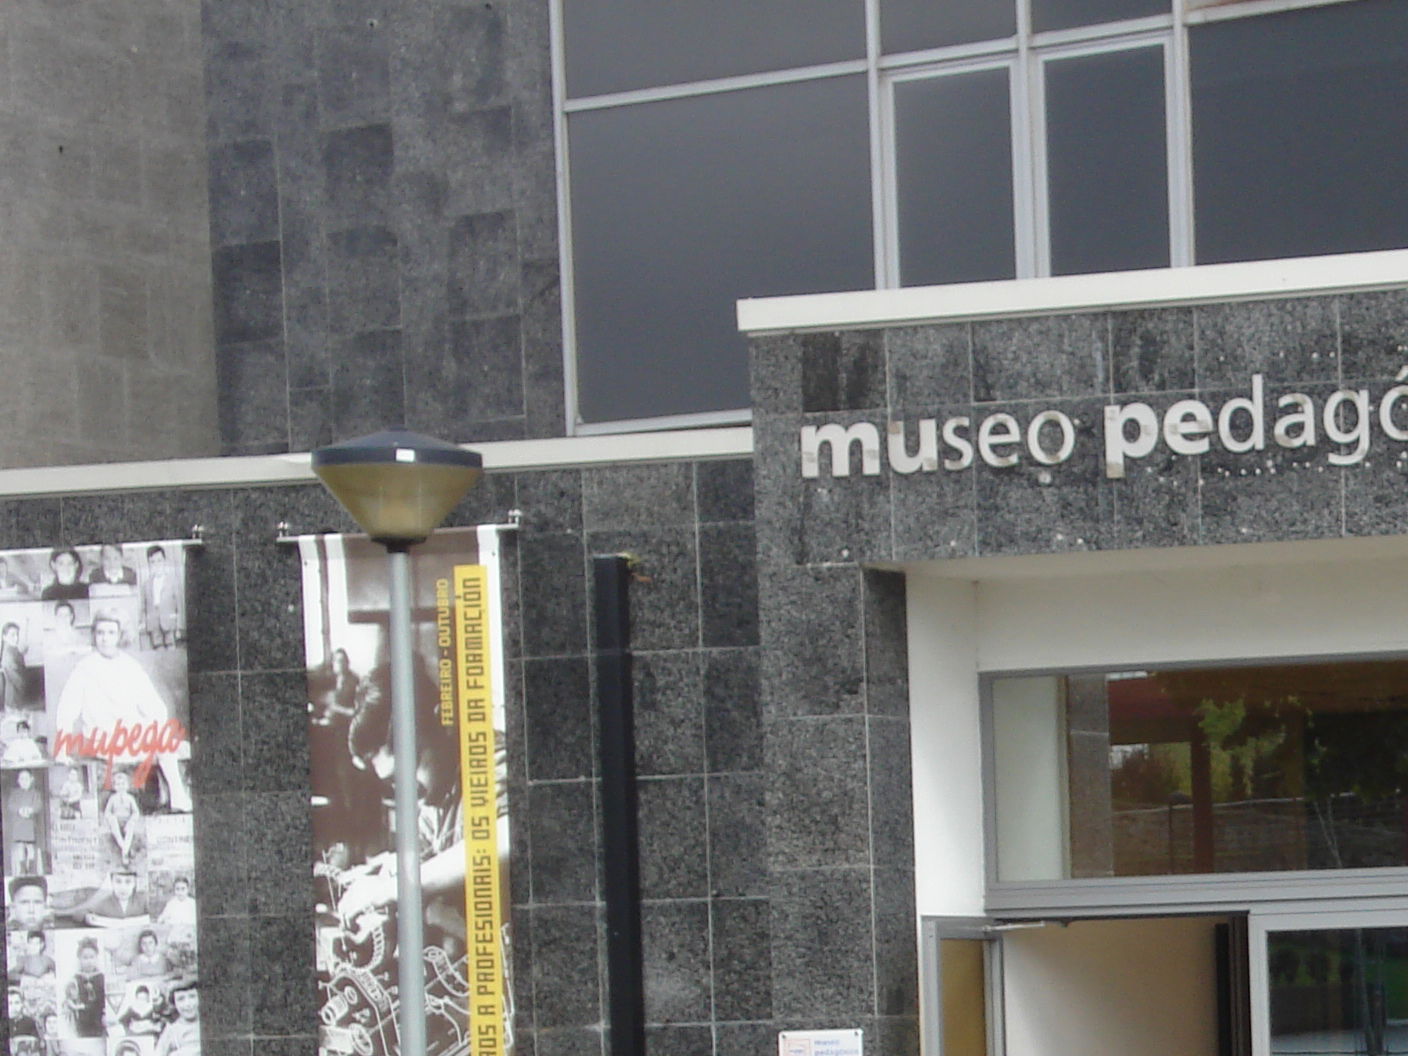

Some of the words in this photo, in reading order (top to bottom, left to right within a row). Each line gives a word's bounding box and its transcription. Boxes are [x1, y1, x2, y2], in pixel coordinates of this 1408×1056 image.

[801, 410, 1076, 478] museo
[437, 578, 451, 647] OUTUBRO
[455, 577, 484, 690] FORMACIÓN
[440, 659, 454, 726] FEBREIRO
[467, 698, 487, 723] DA
[53, 717, 187, 790] mupega
[468, 731, 489, 807] VIEIROS
[471, 816, 490, 840] OS
[472, 848, 496, 996] PROFESIONAIS:
[478, 1005, 496, 1016] A
